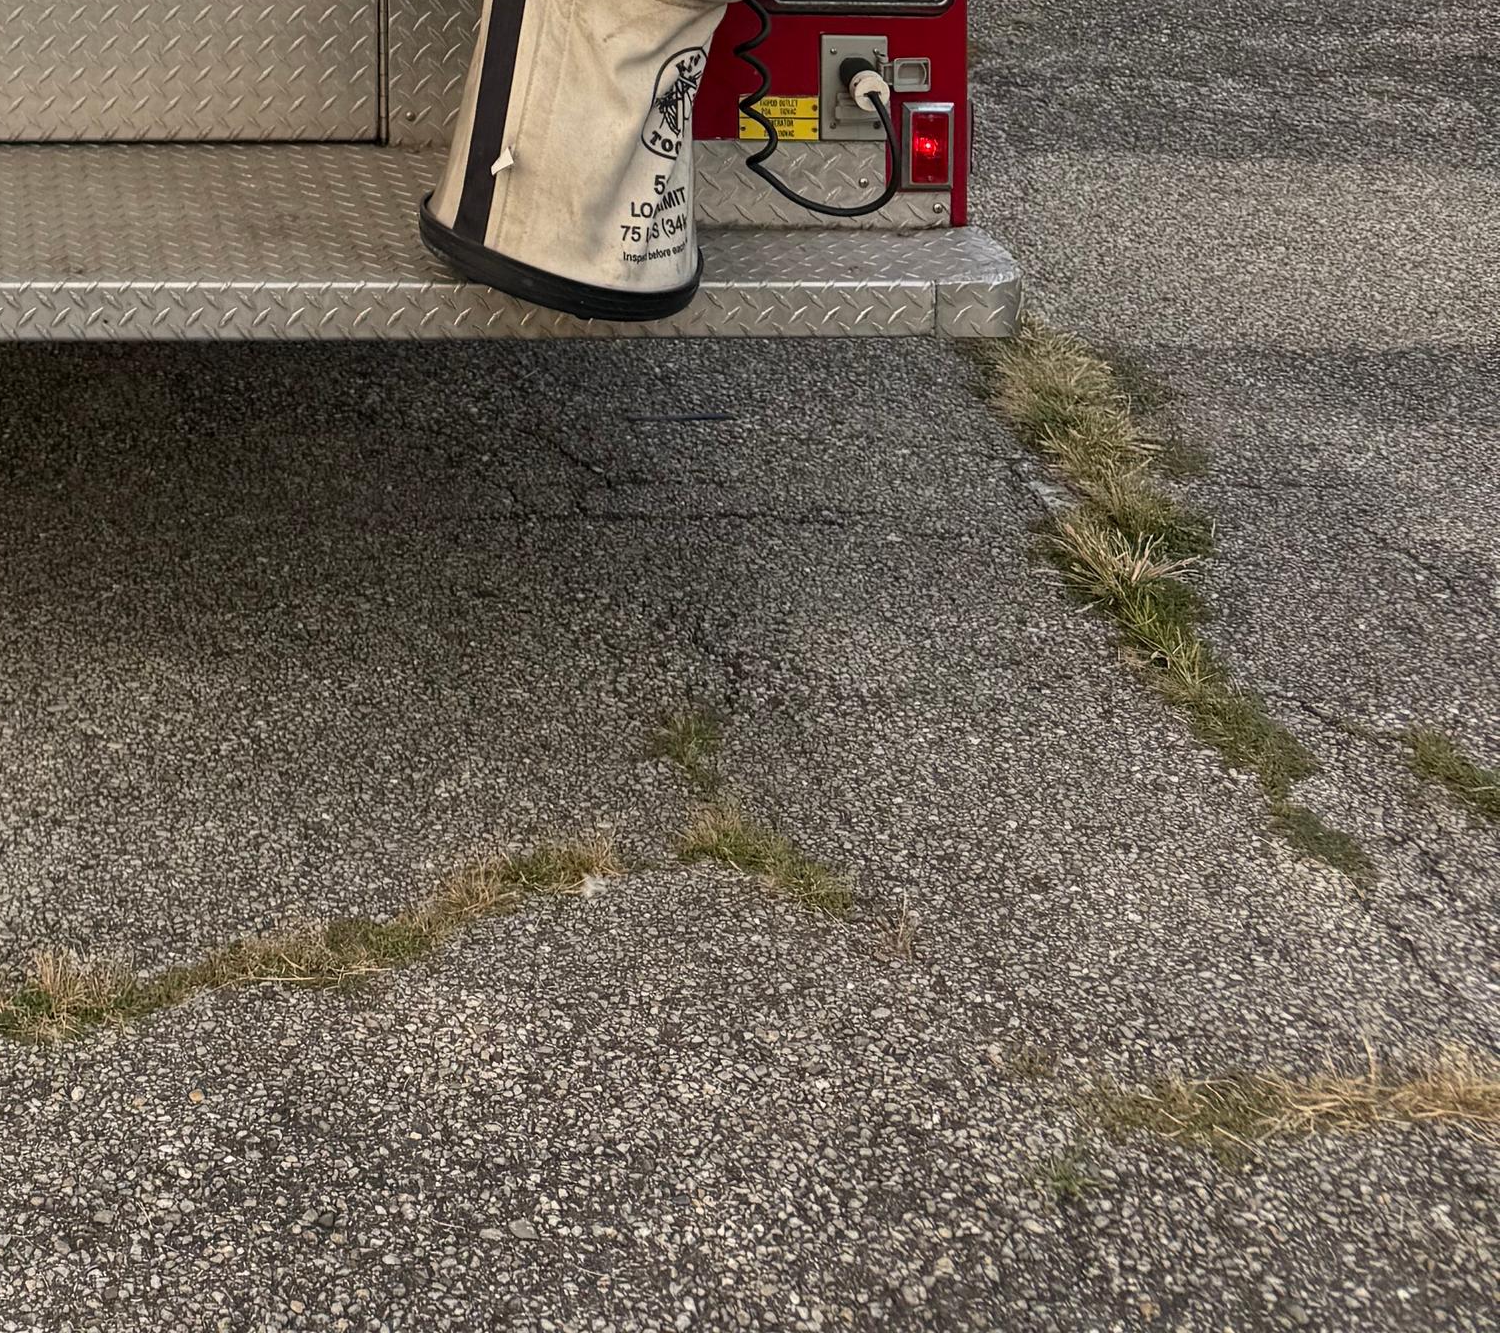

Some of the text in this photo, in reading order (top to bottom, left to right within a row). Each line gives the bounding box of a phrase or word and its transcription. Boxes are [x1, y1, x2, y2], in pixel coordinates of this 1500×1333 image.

[631, 201, 654, 219] LO
[620, 225, 641, 242] 75
[648, 247, 671, 260] before
